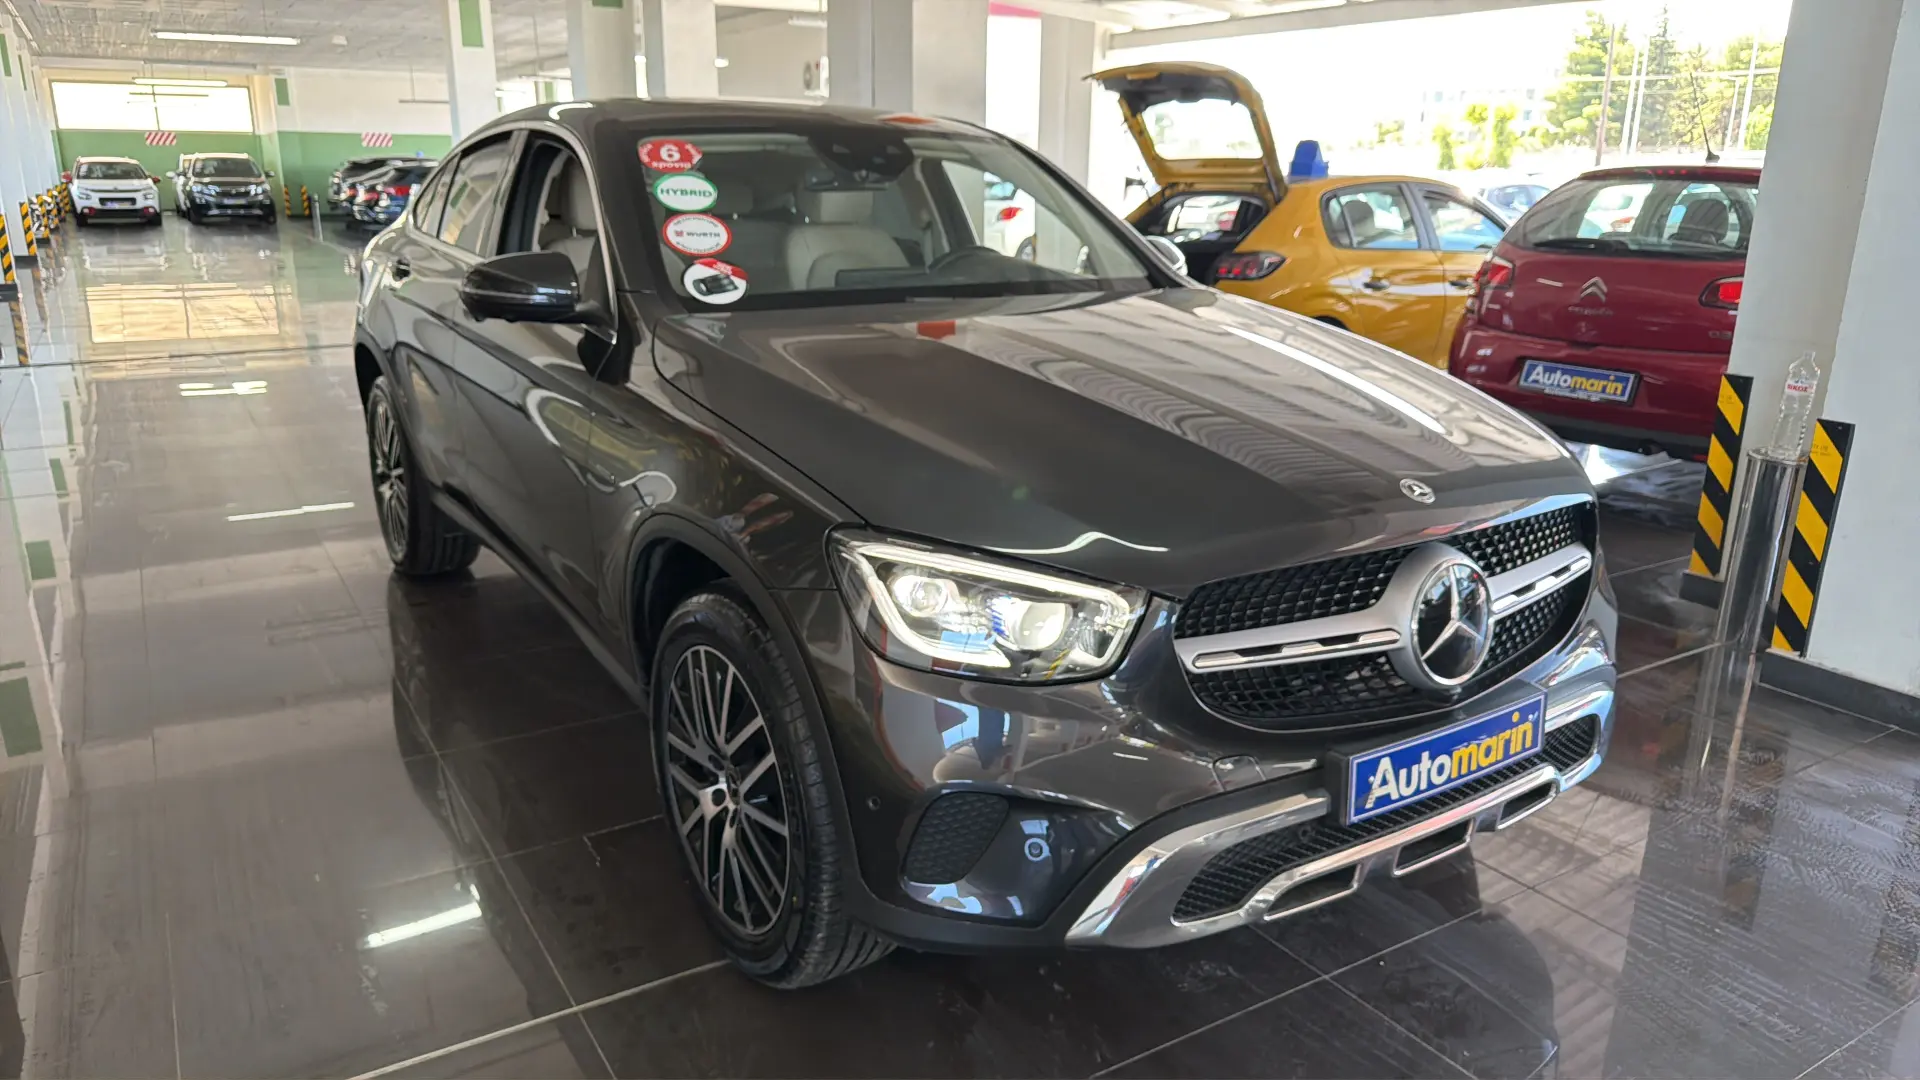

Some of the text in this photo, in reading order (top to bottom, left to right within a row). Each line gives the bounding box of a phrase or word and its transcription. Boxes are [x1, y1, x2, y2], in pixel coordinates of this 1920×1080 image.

[659, 143, 681, 162] 6
[660, 187, 713, 198] HYBRID
[1527, 364, 1624, 396] Automarin
[1364, 711, 1533, 810] Automarin
